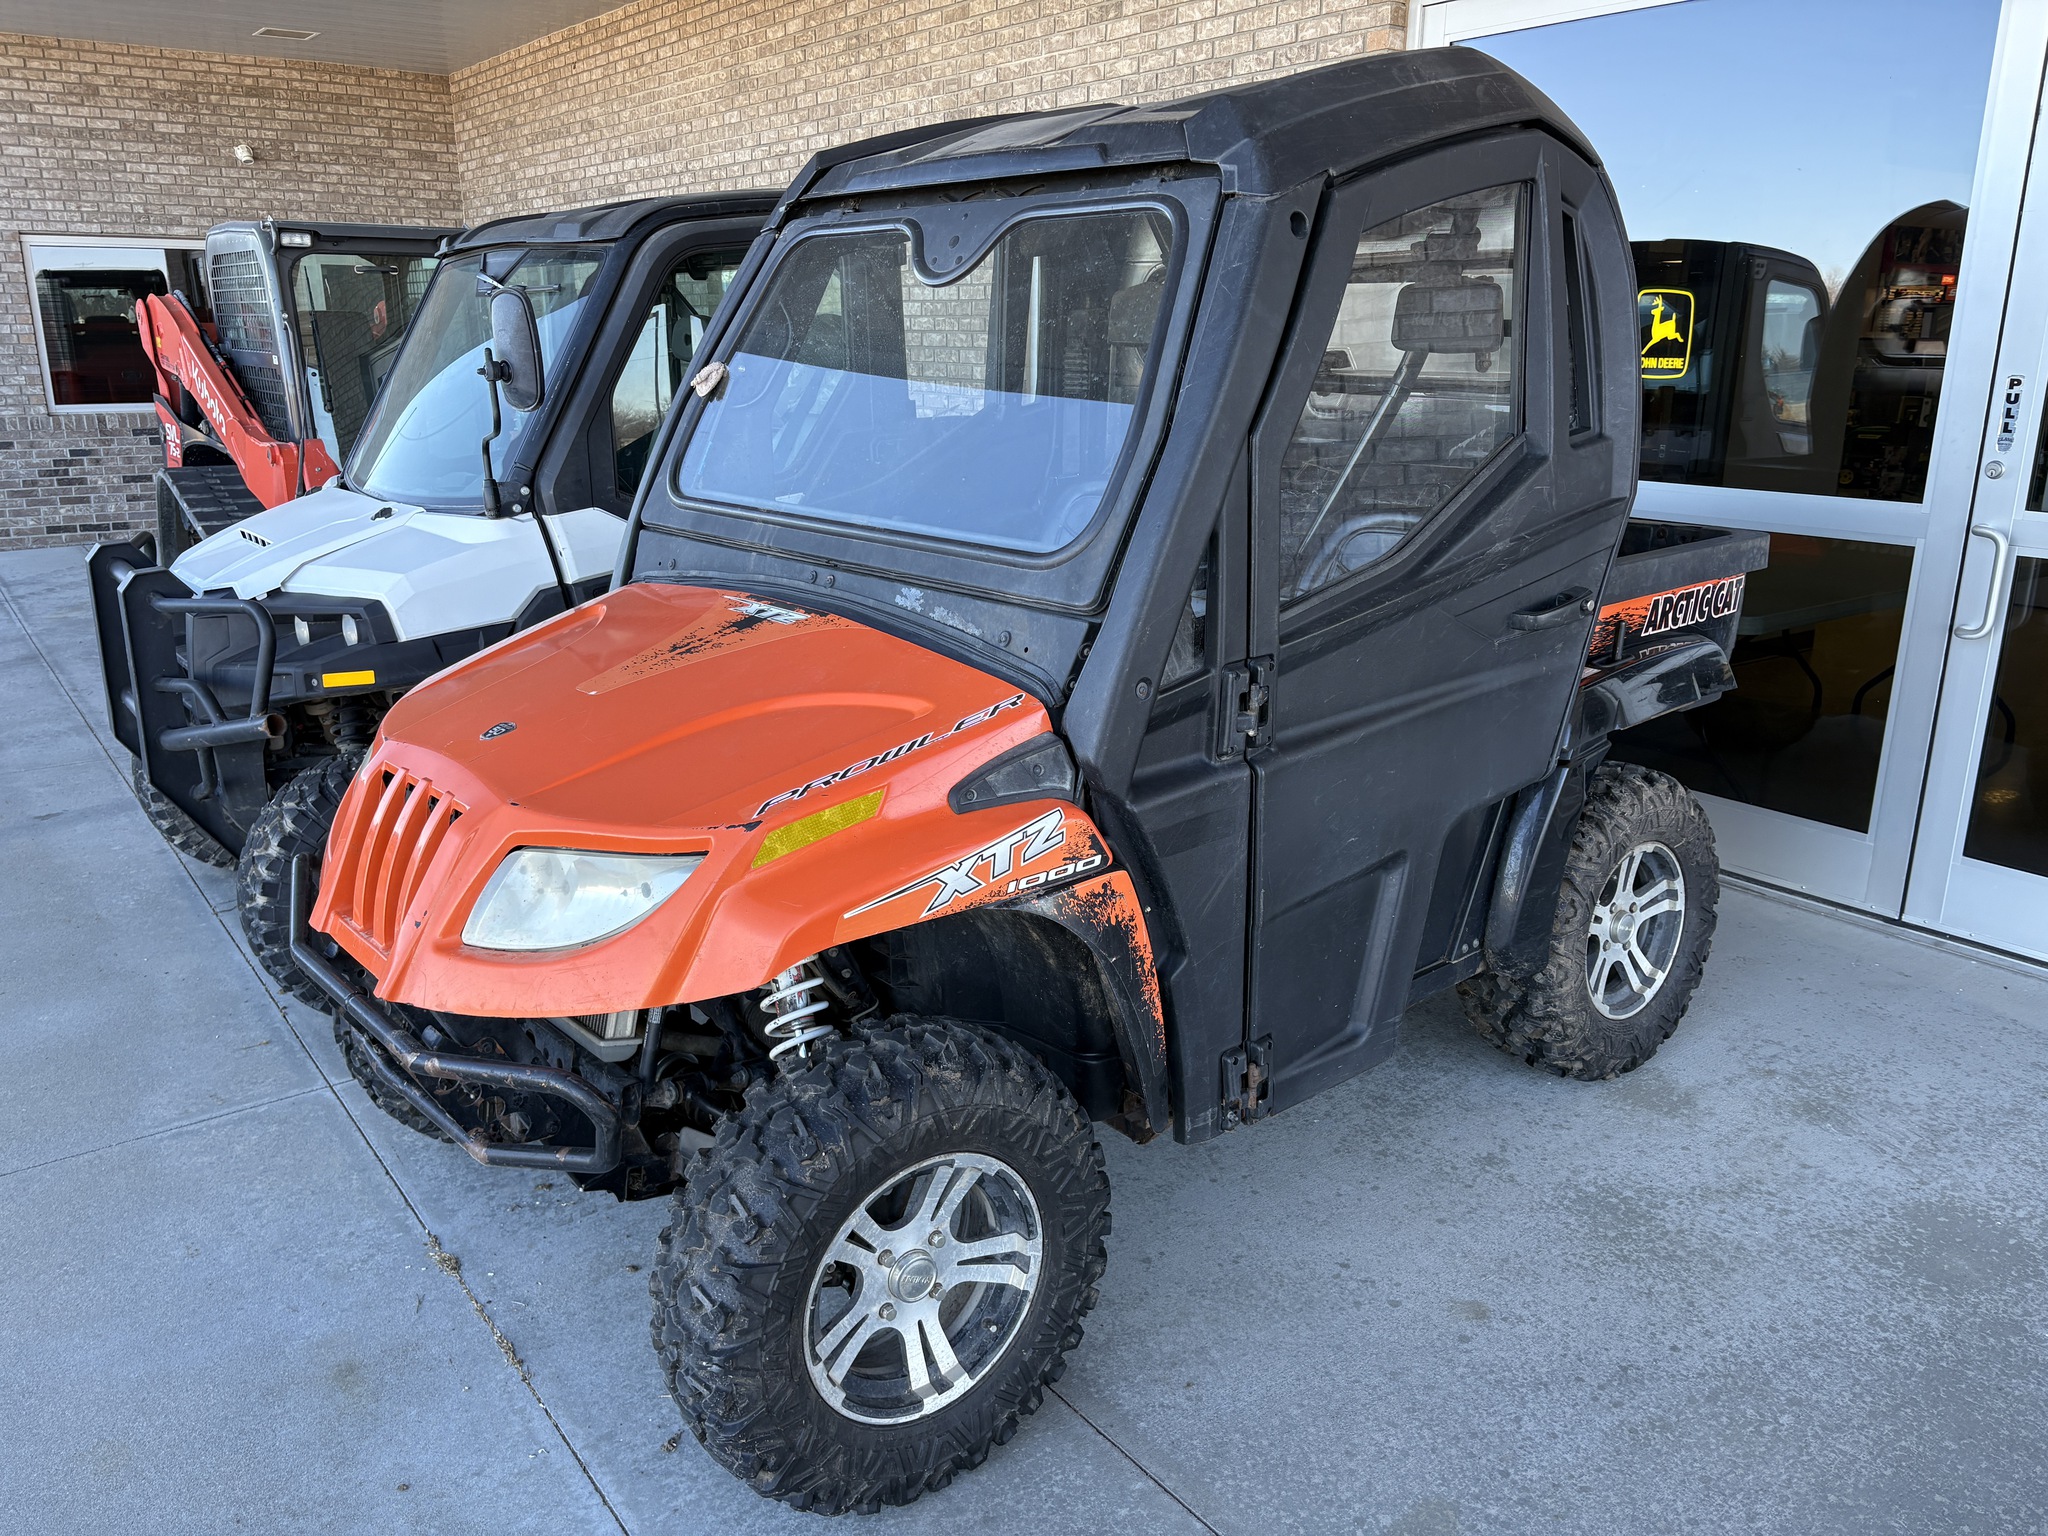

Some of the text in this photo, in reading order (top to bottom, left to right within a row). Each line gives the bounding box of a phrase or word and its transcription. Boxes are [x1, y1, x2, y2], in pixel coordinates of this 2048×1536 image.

[1641, 357, 1684, 369] OHN DEERE
[191, 359, 227, 437] Kubota
[2003, 378, 2022, 433] PULL
[165, 422, 180, 444] SVL
[723, 595, 812, 625] XTZ
[1641, 575, 1746, 637] ARCTIC CAT
[752, 692, 1026, 819] PROWLER
[843, 806, 1067, 919] XTZ
[1006, 854, 1102, 894] 1000
